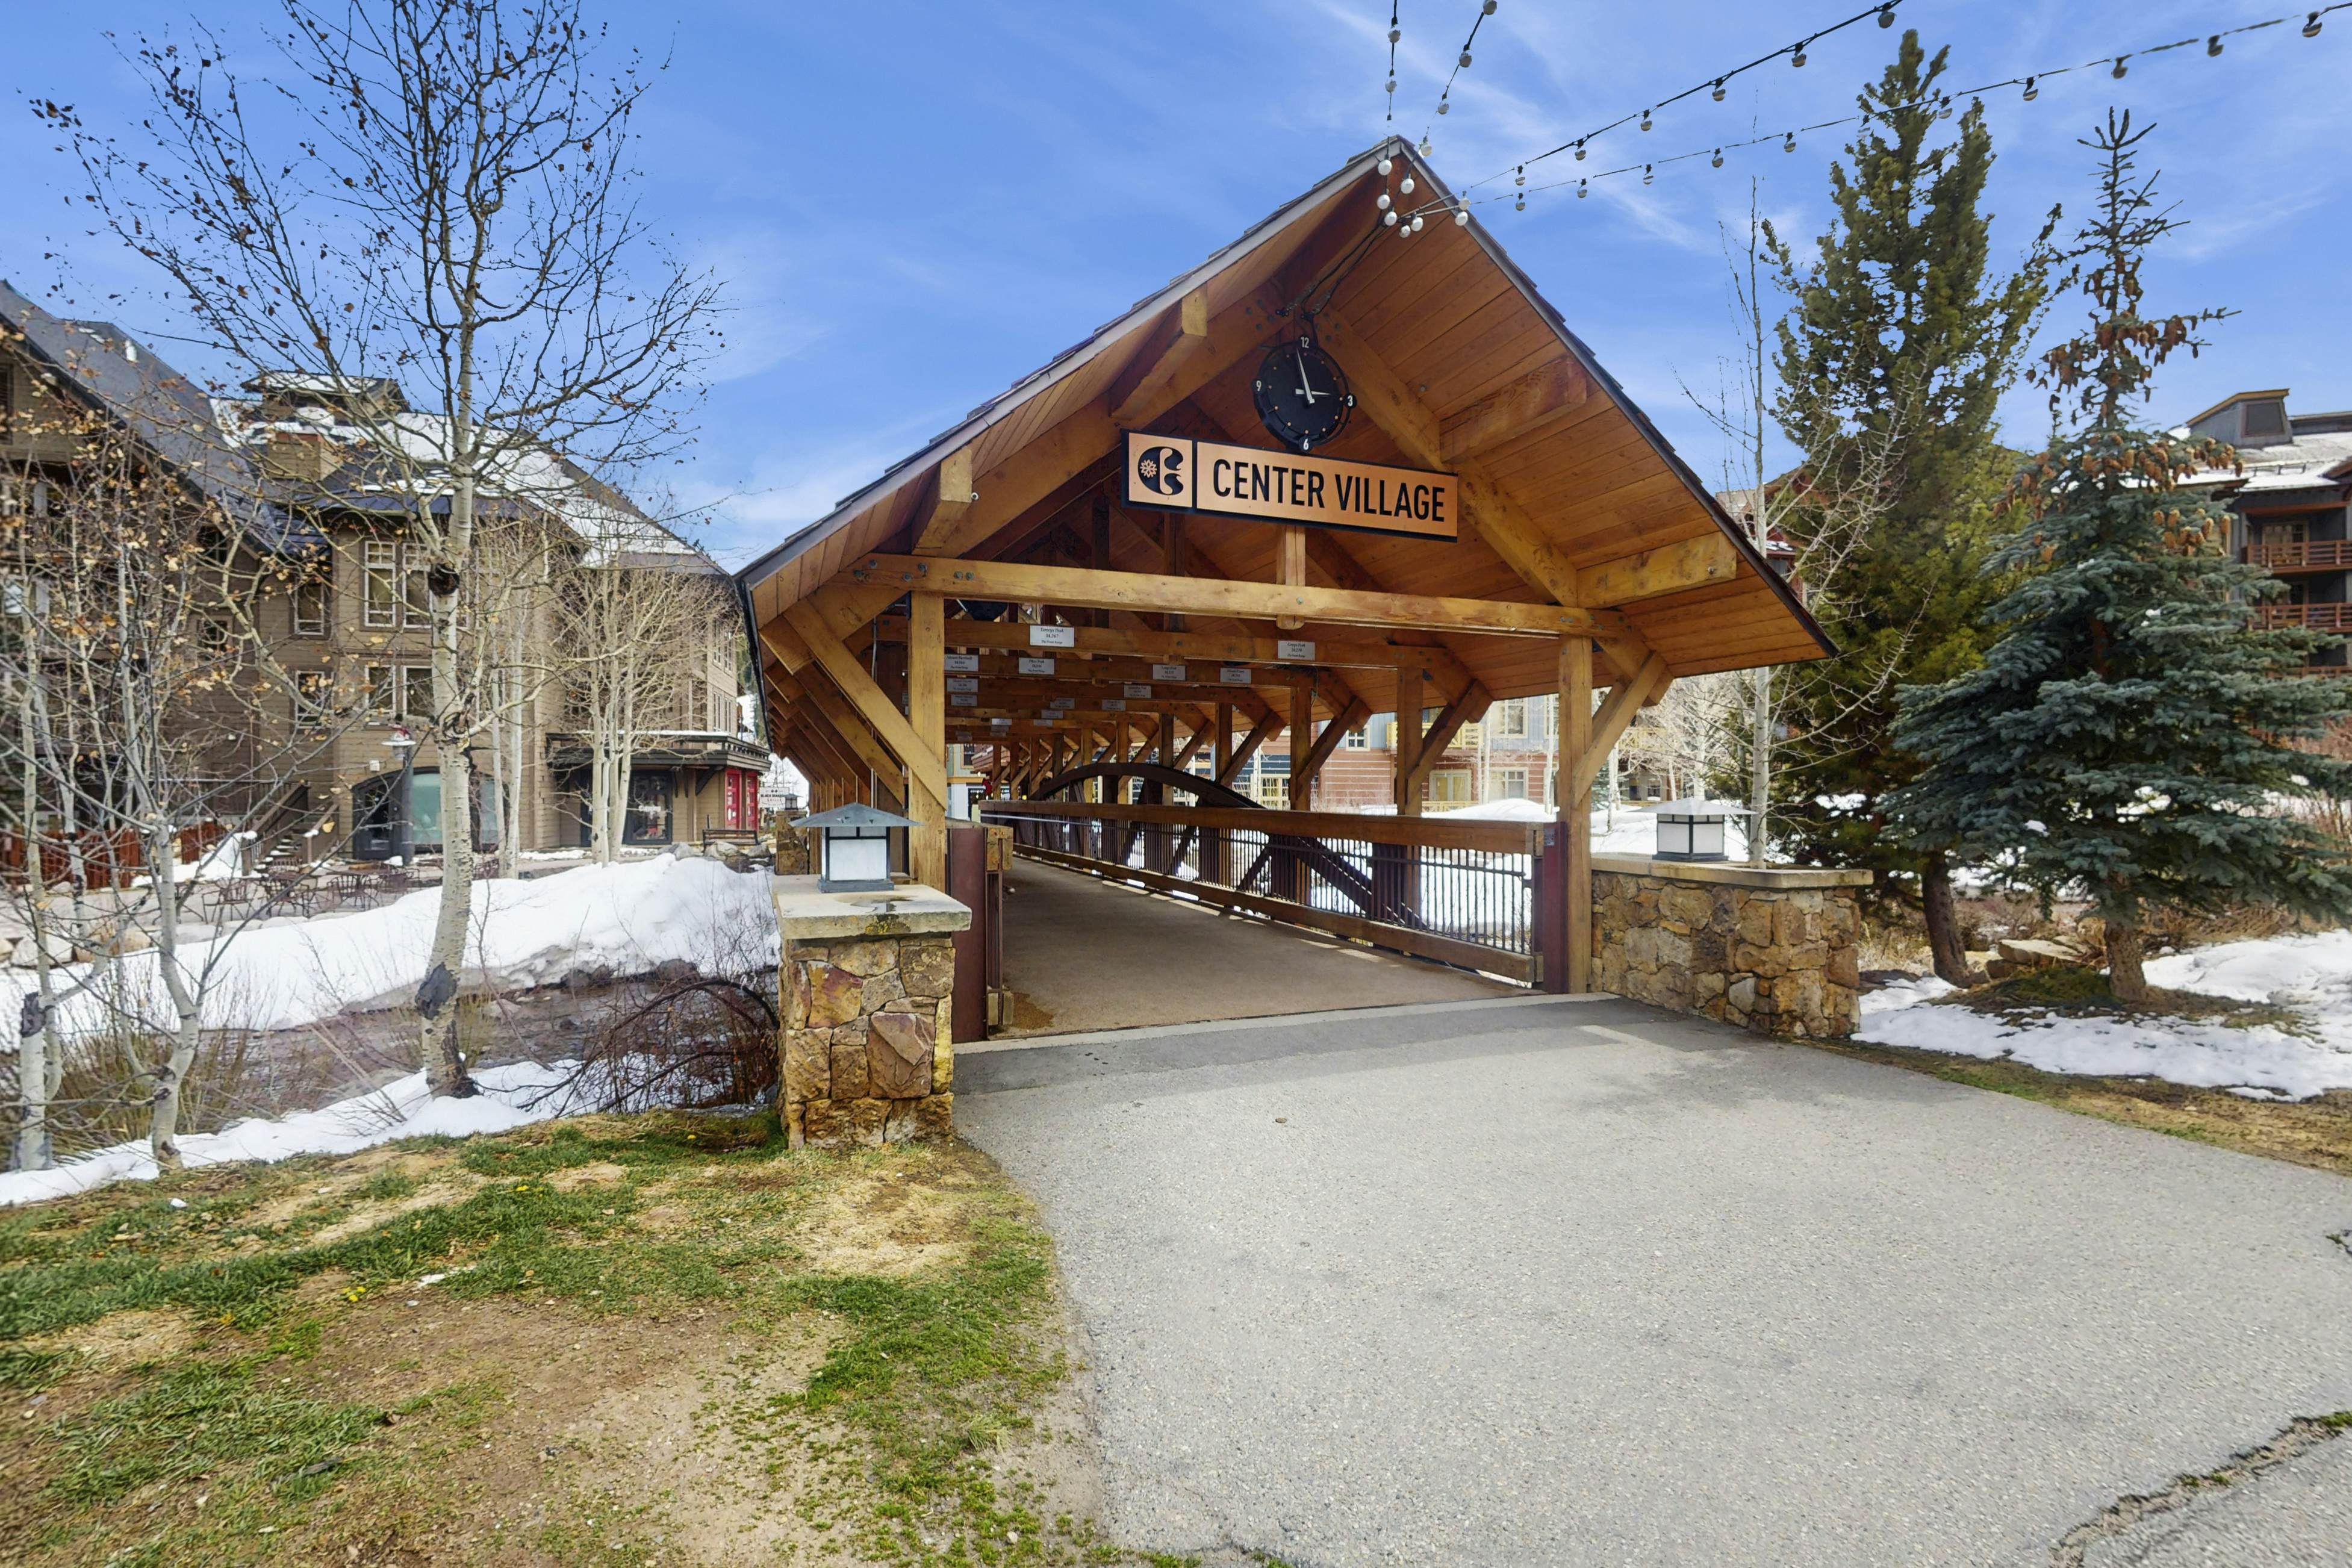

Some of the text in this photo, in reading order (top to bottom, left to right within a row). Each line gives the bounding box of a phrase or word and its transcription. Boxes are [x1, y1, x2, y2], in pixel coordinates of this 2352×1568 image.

[1301, 337, 1310, 348] 12
[1256, 380, 1262, 391] 9
[1347, 395, 1354, 406] 3
[1303, 438, 1309, 450] 6
[1213, 459, 1445, 522] CENTER VILLAGE
